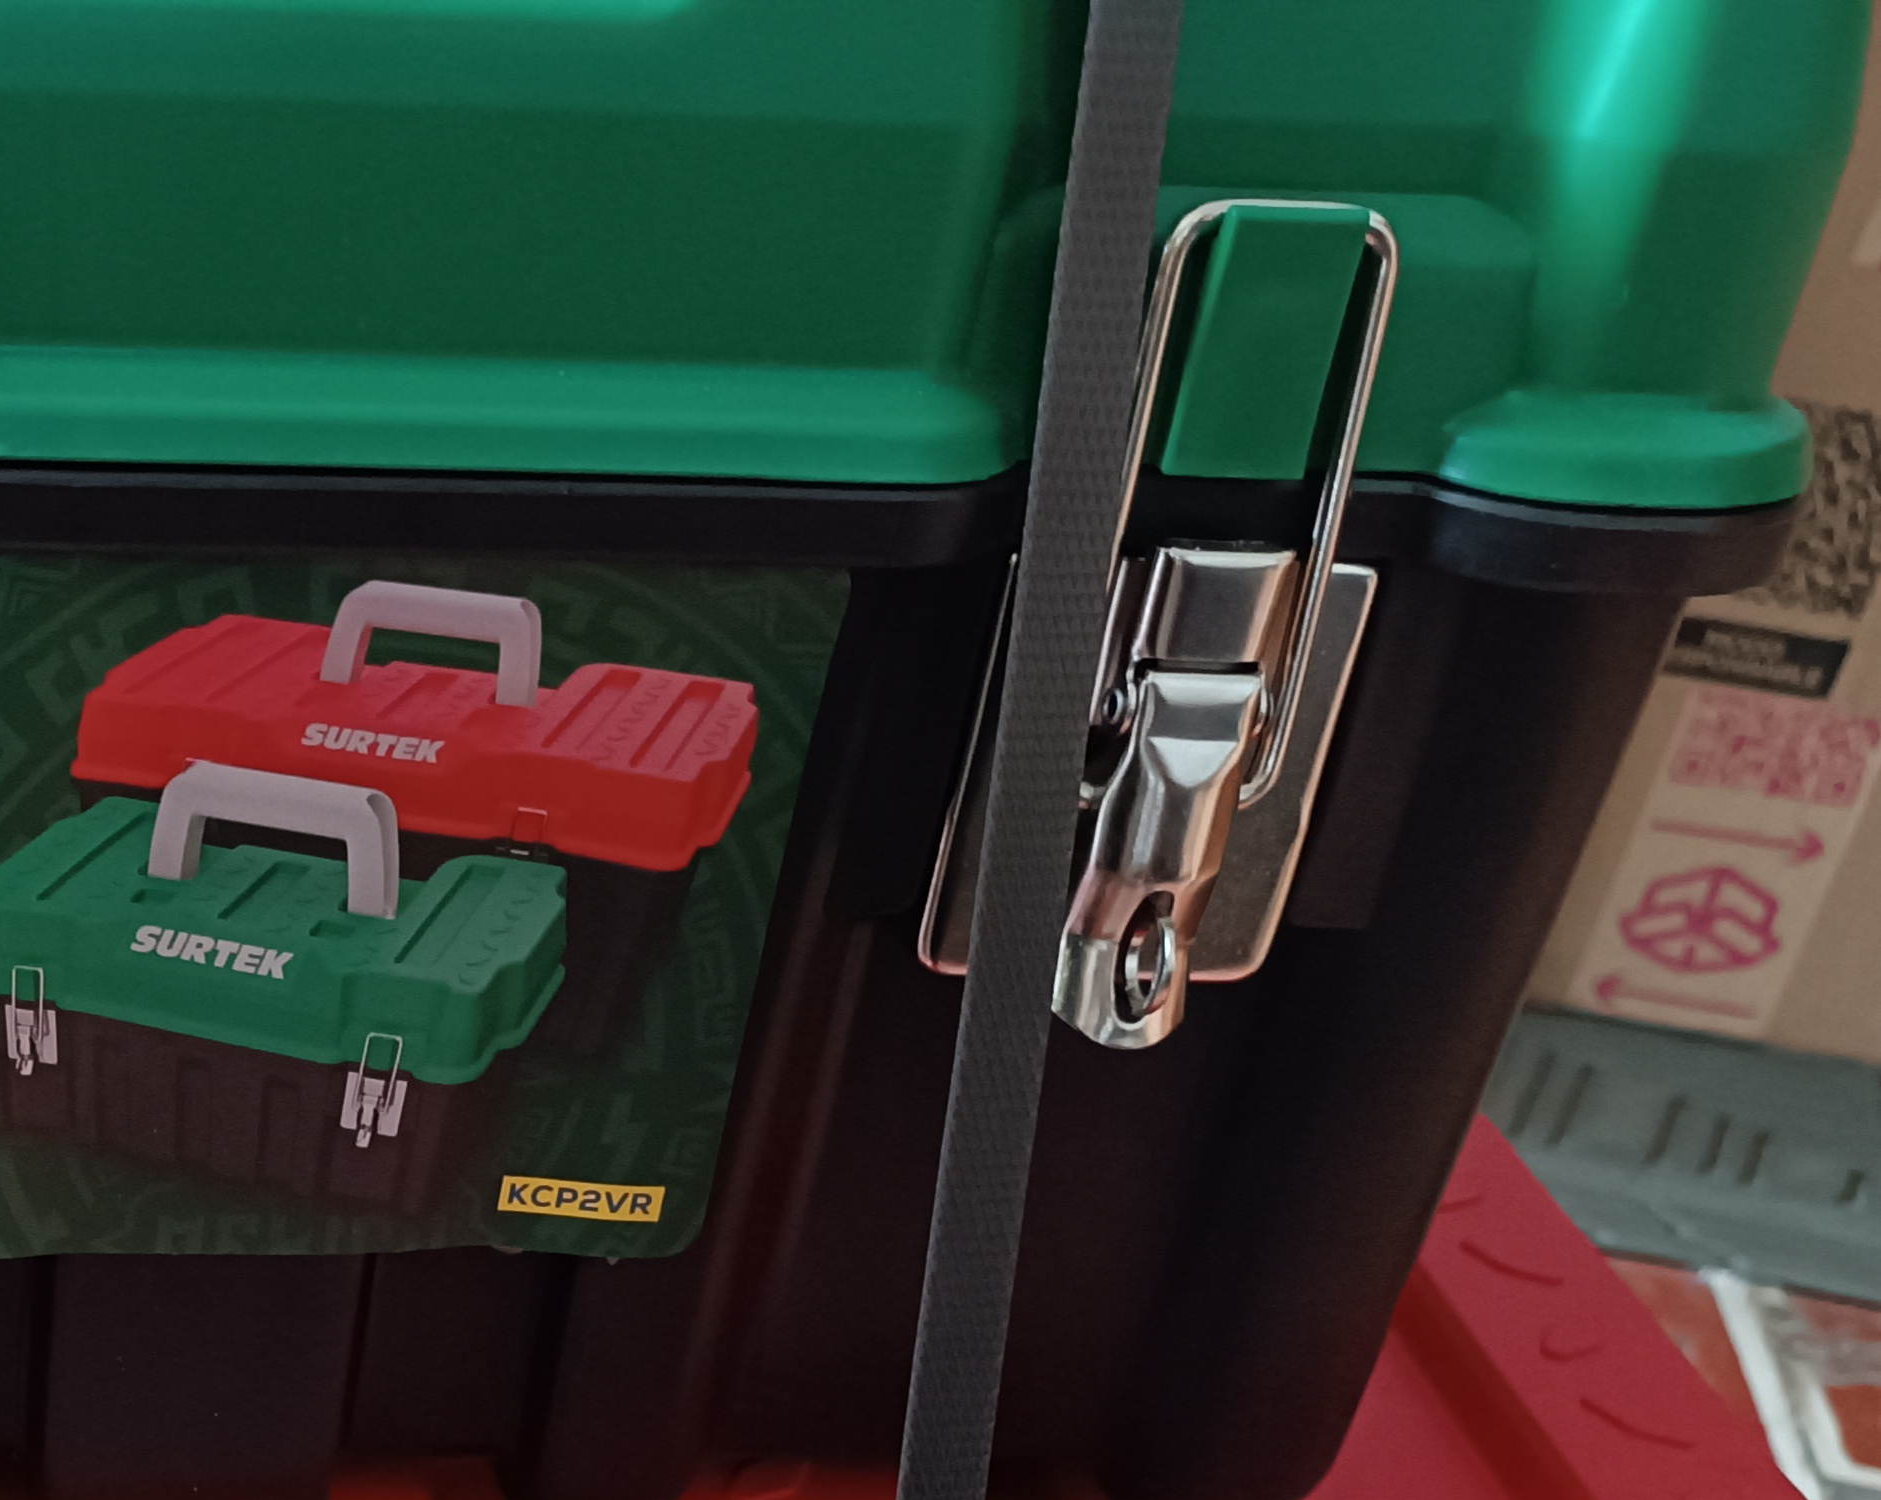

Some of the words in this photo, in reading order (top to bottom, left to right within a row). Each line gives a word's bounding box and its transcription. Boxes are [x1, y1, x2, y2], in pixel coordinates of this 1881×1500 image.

[301, 723, 445, 764] SURTEK
[130, 925, 294, 980] SURTEK
[507, 1182, 653, 1215] KCP2VR
